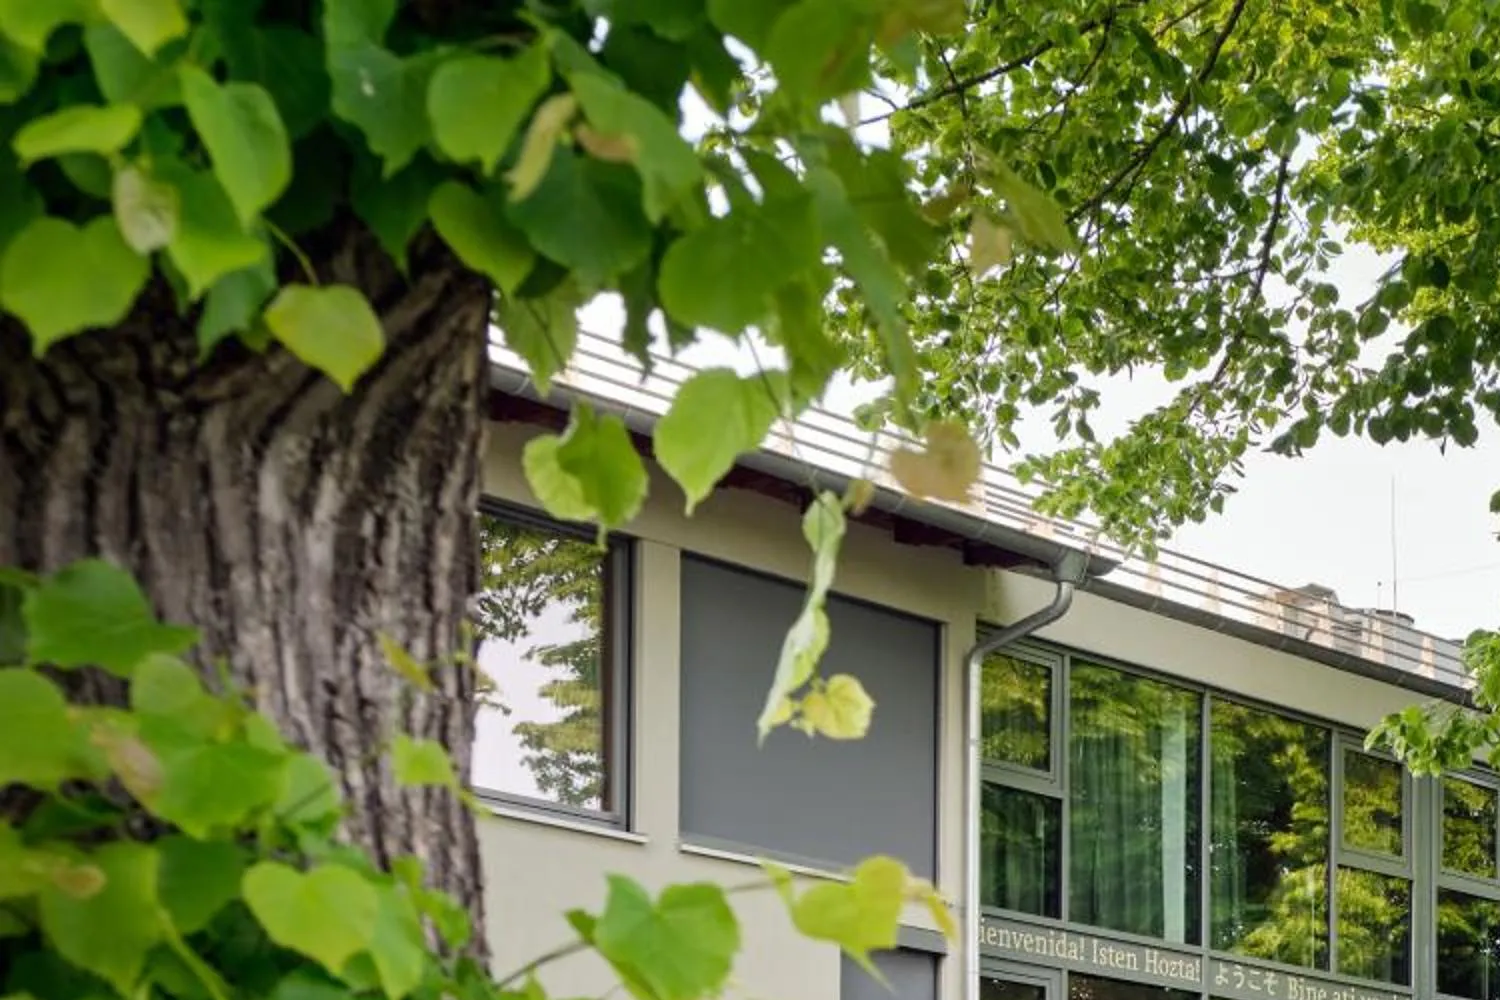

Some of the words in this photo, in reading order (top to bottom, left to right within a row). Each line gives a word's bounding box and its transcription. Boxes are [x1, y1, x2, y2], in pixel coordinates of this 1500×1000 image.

[978, 917, 1085, 961] ienvenida!
[1091, 938, 1139, 971] Isten
[1214, 962, 1279, 996] ようこそ
